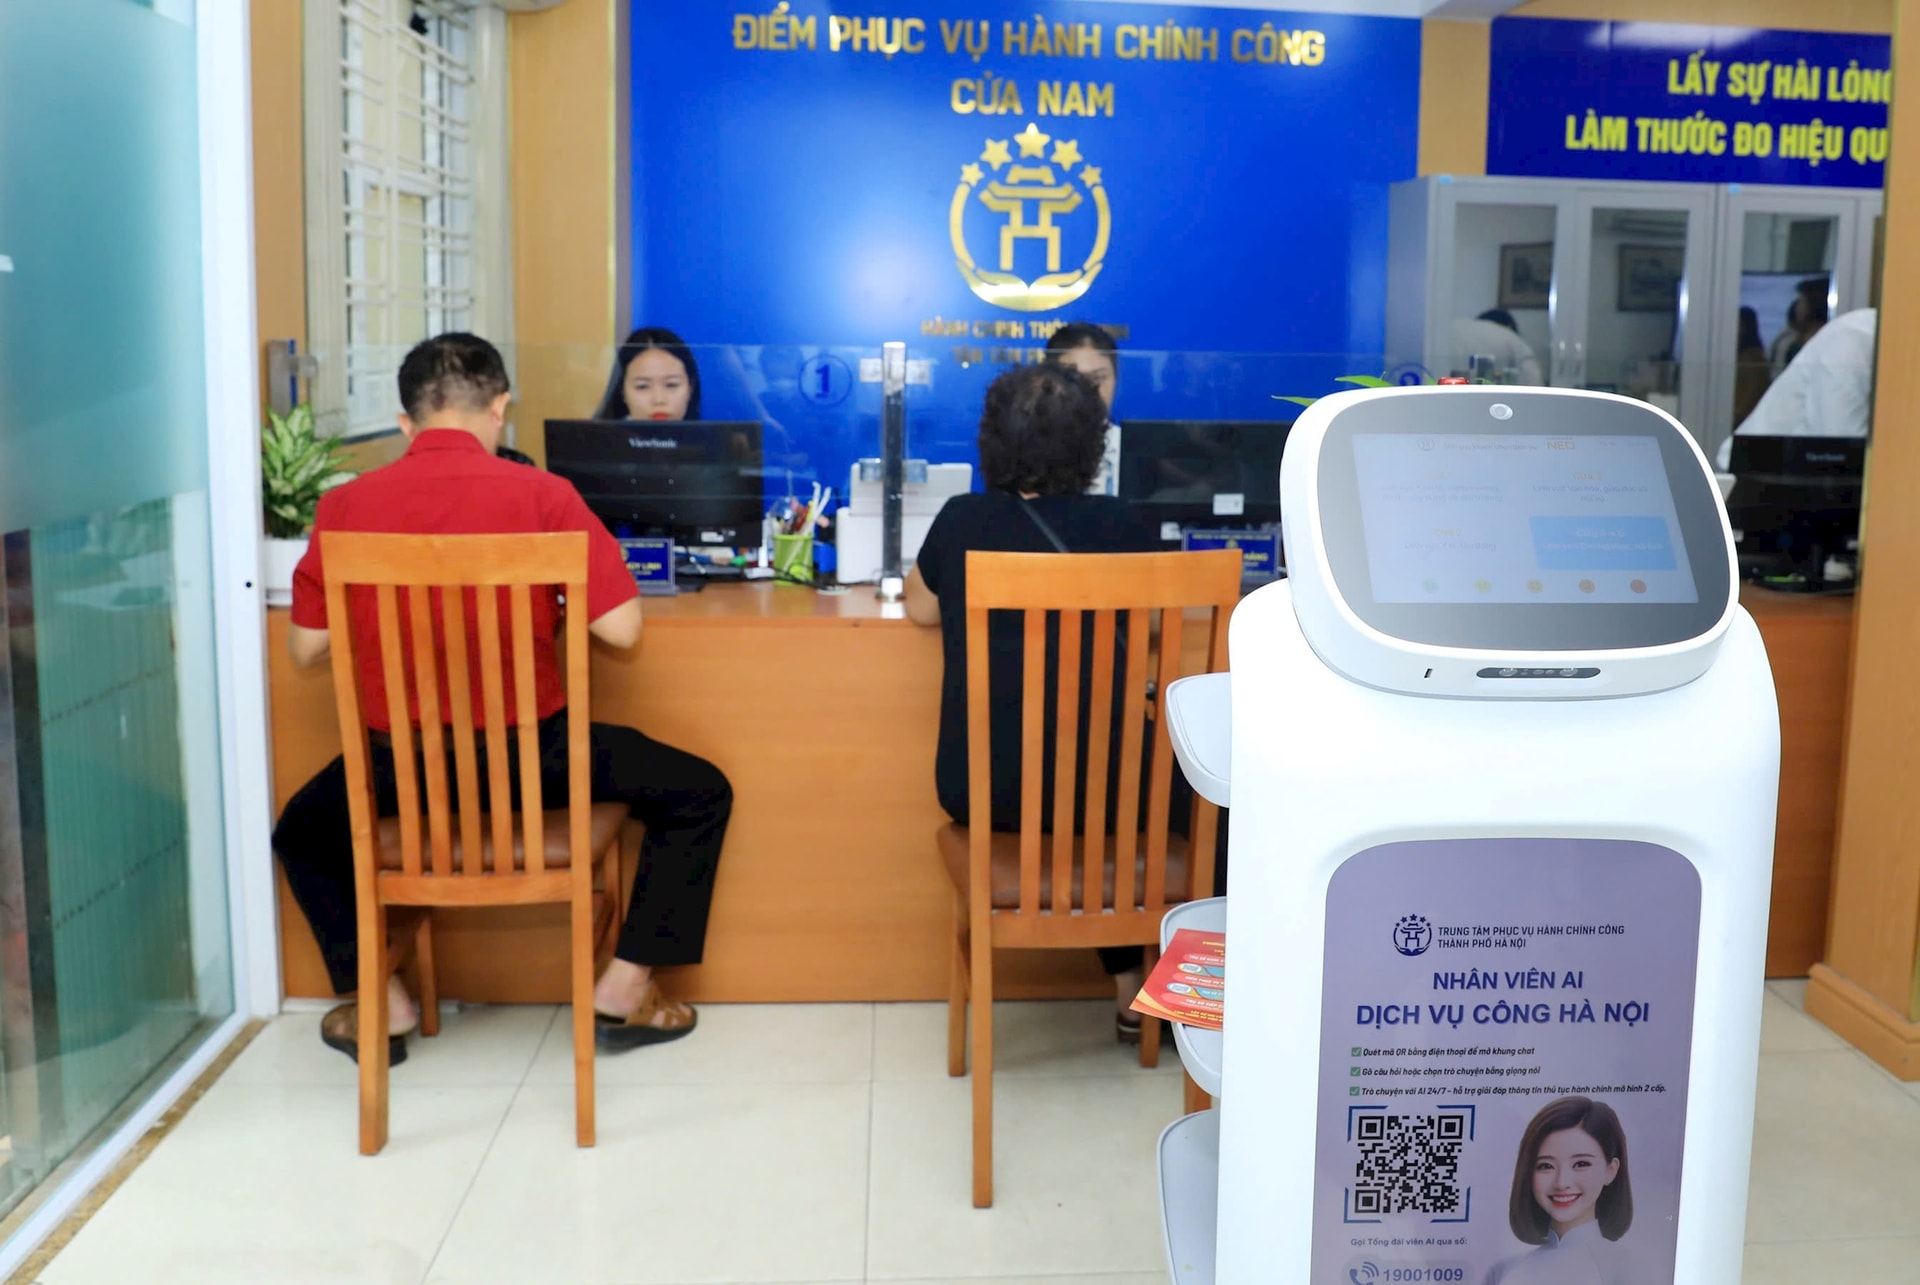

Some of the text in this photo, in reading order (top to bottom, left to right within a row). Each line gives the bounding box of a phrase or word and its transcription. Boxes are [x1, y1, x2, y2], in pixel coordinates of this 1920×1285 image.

[732, 1, 1325, 66] ĐIỂM PHỤC VỤ HÀNH CHÍNH CÔNG
[1667, 50, 1721, 96] LẤY
[1727, 60, 1771, 105] SỰ
[1773, 58, 1821, 100] HÀI
[951, 71, 1114, 117] CỬA NAM
[1565, 108, 1628, 151] LÀM
[1635, 110, 1727, 156] THƯỚC
[1733, 122, 1772, 157] ĐO
[1778, 118, 1844, 167] HIỆU
[815, 364, 829, 398] 1
[1438, 923, 1625, 938] TRUNG TÂM PHỤC VỤ HÀNH CHÍNH CÔNG
[1438, 936, 1526, 950] THÀNH PHỐ HÀ NỘI
[1433, 967, 1583, 990] NHÂN VIÊN AI
[1356, 998, 1649, 1029] DỊCH VỤ CÔNG HÀ NỘI
[1363, 1048, 1381, 1057] Quét
[1396, 1048, 1406, 1057] QR
[1428, 1047, 1445, 1058] điện
[1446, 1047, 1466, 1058] thoại
[1467, 1045, 1479, 1055] để
[1492, 1047, 1515, 1056] khung
[1517, 1047, 1535, 1055] chat
[1374, 1067, 1388, 1075] câu
[1423, 1067, 1443, 1077] chọn
[1456, 1066, 1484, 1078] chuyện
[1506, 1066, 1527, 1077] giọng
[1528, 1066, 1541, 1075] nói
[1361, 1087, 1374, 1096] Trò
[1375, 1086, 1403, 1098] chuyện
[1418, 1087, 1426, 1095] AI
[1427, 1086, 1446, 1095] 24/7
[1464, 1086, 1476, 1096] trợ
[1508, 1085, 1530, 1096] thông
[1531, 1085, 1542, 1094] tin
[1557, 1085, 1570, 1096] tục
[1571, 1084, 1590, 1093] hành
[1591, 1084, 1612, 1093] chính
[1626, 1084, 1643, 1092] hình
[1644, 1084, 1650, 1092] 2
[1350, 1238, 1365, 1247] Gọi
[1368, 1237, 1389, 1247] Tổng
[1454, 1237, 1468, 1245] số:
[1383, 1268, 1463, 1282] 19001009
